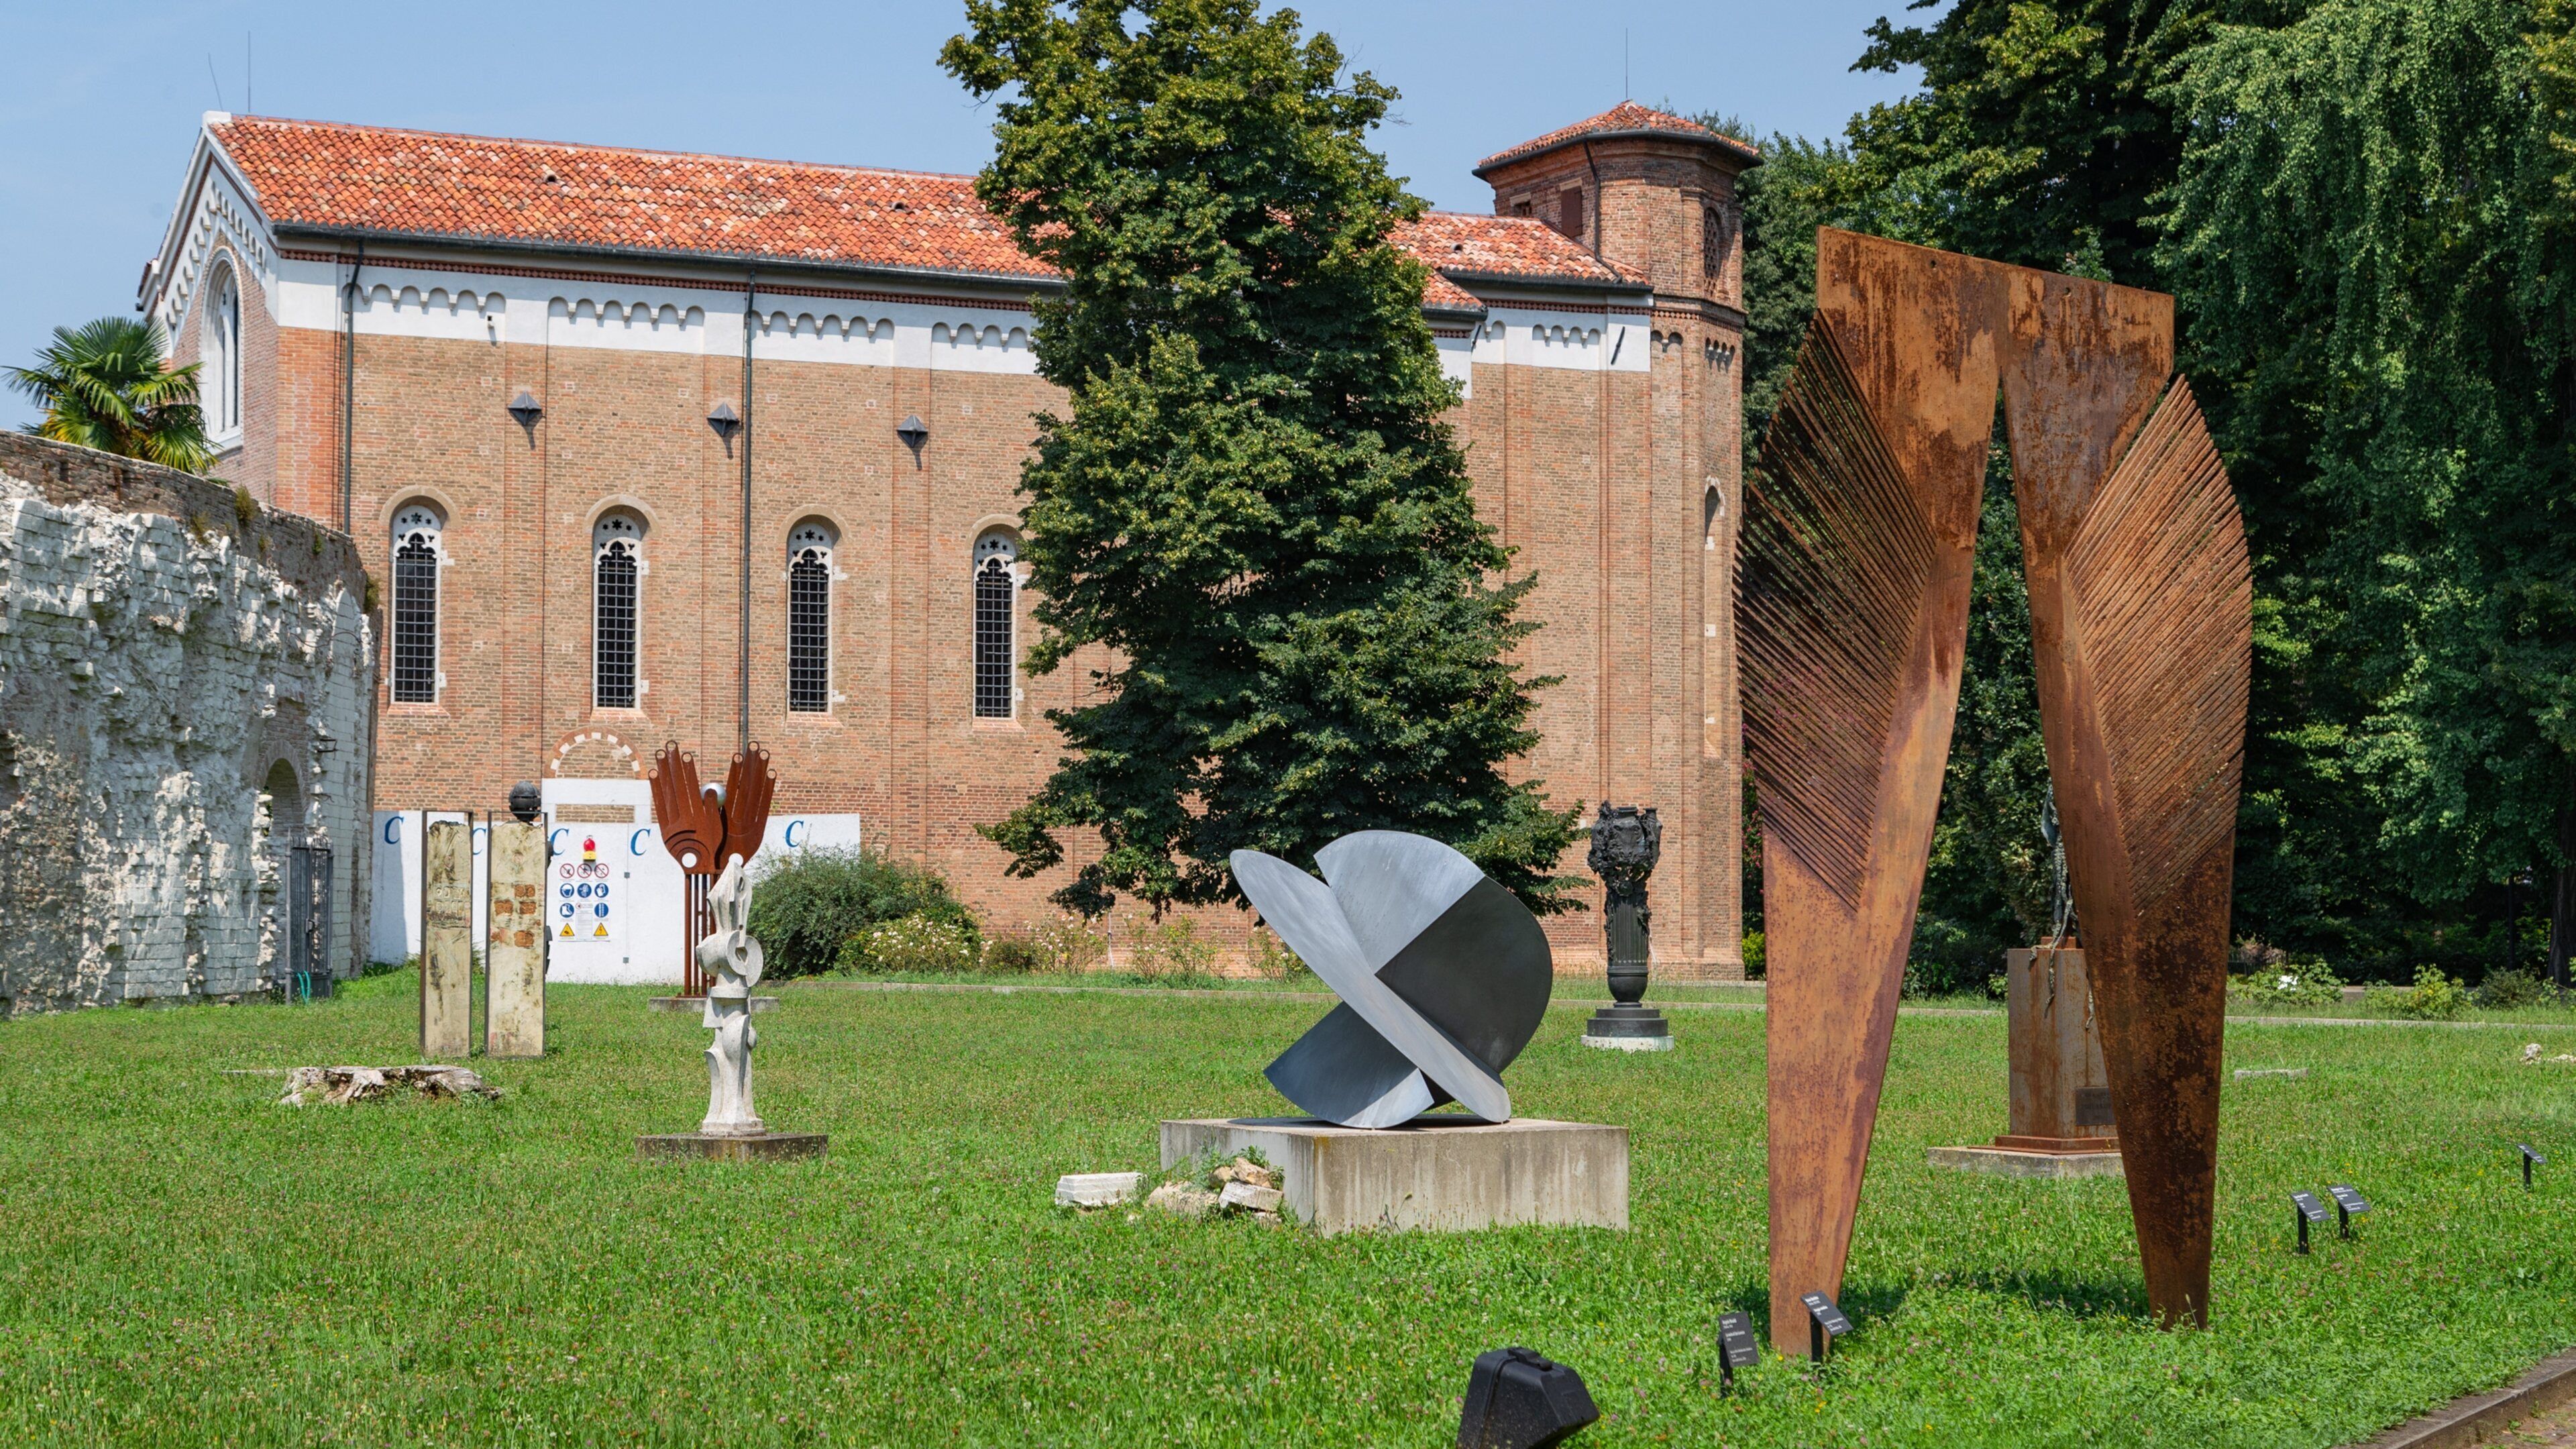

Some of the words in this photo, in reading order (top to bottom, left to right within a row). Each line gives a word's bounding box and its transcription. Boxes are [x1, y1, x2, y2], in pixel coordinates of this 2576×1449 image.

[384, 816, 405, 845] C
[549, 828, 570, 856] C
[630, 828, 651, 856] C
[785, 820, 804, 848] C
